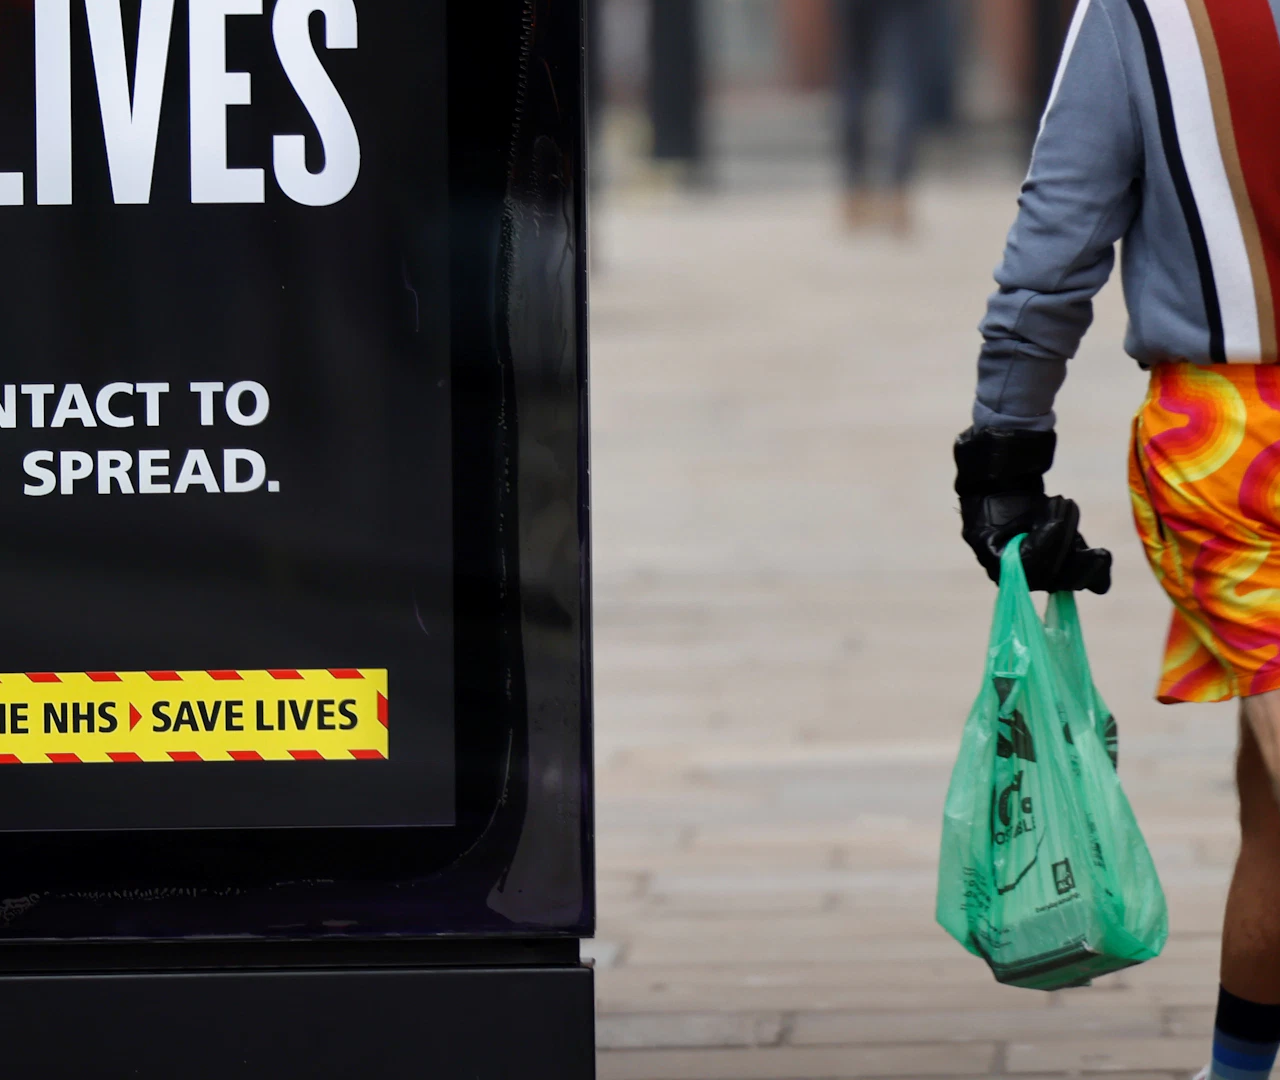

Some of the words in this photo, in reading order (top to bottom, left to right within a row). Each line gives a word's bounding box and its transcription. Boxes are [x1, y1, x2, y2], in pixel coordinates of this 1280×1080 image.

[190, 380, 270, 427] TO
[22, 448, 280, 496] SPREAD.
[44, 702, 118, 734] NHS
[152, 700, 244, 732] SAVE
[256, 699, 358, 731] LIVES
